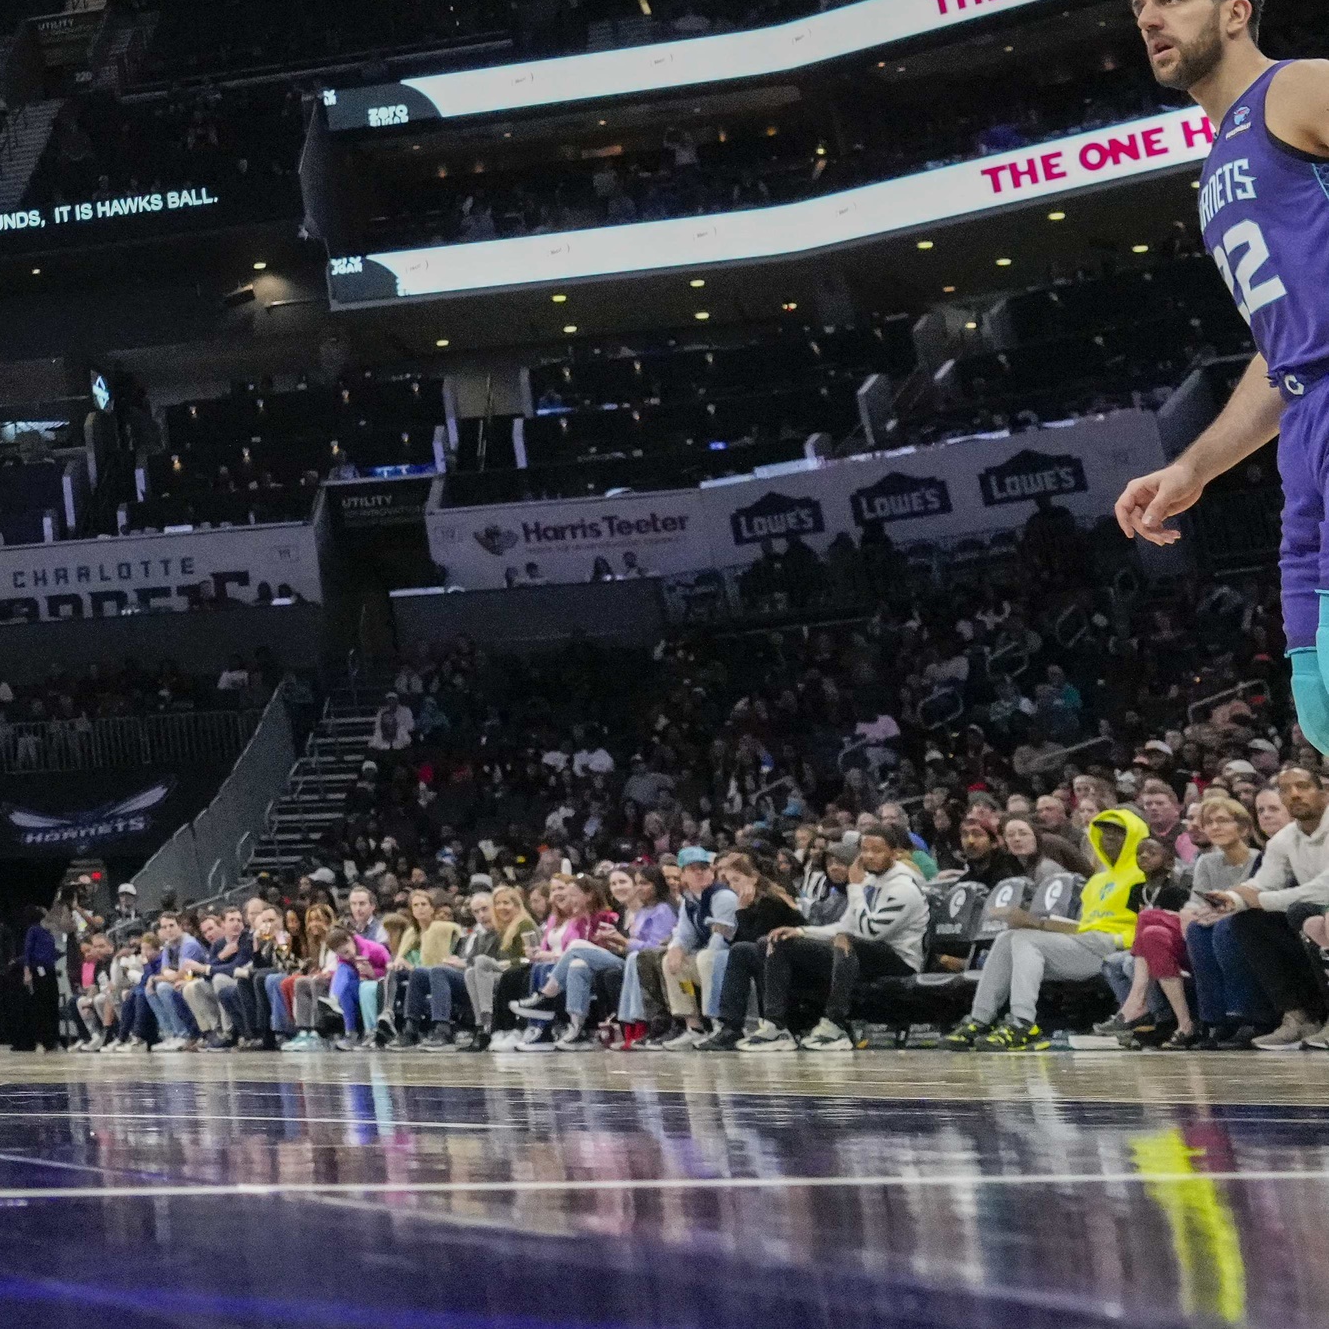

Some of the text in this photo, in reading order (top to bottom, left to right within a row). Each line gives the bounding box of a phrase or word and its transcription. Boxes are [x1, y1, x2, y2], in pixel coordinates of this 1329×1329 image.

[980, 151, 1067, 194] THE
[1078, 127, 1168, 171] ONE
[54, 205, 71, 223] IT
[75, 204, 92, 220] IS
[96, 194, 163, 218] HAWKS
[167, 188, 218, 209] BALL.
[990, 467, 1076, 499] LOWE'S
[342, 495, 392, 508] UTILITY
[859, 488, 941, 520] LOWE'S
[523, 517, 599, 543] Harris
[602, 513, 689, 539] Teeter
[740, 507, 814, 537] LOWE'S
[13, 557, 195, 588] CHARLOTTE
[25, 817, 145, 844] HORNETS
